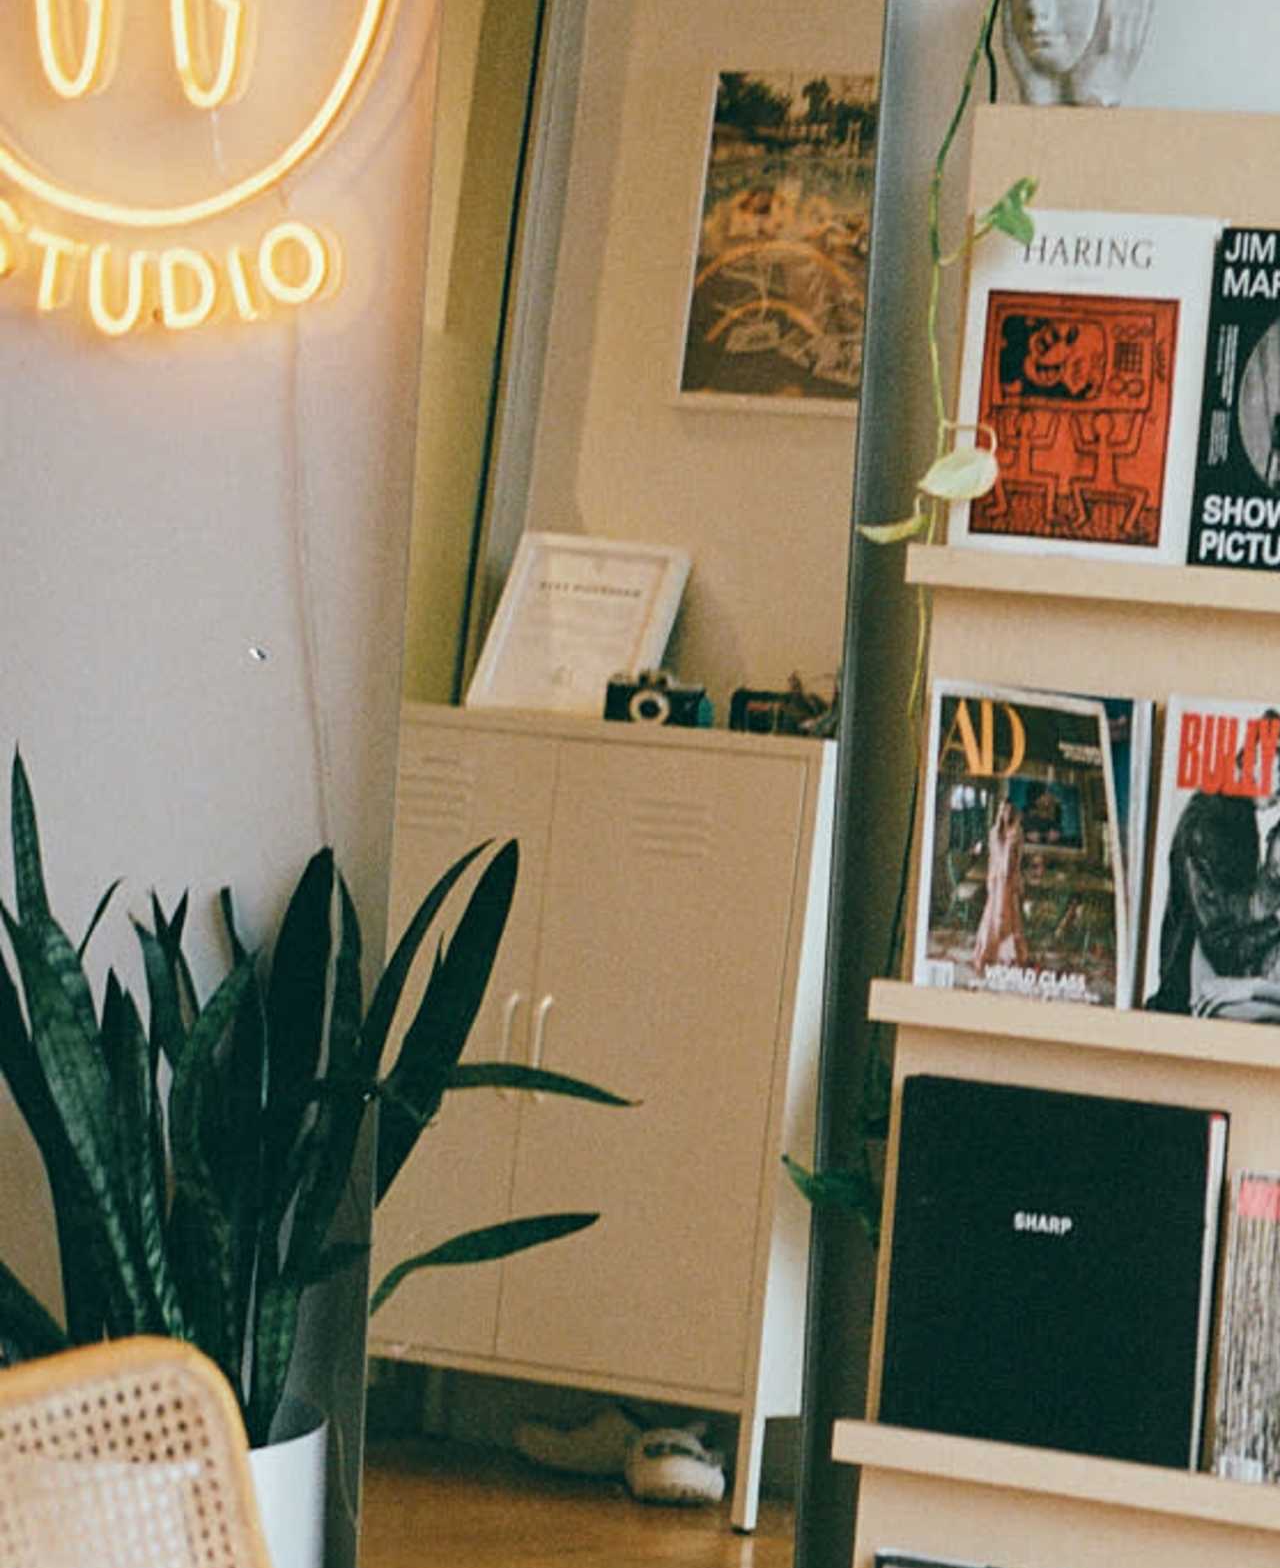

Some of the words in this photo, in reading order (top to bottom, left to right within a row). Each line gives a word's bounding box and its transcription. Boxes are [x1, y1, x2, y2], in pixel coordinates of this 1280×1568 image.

[1023, 234, 1153, 269] HARING
[1224, 233, 1276, 265] JIM
[938, 698, 1026, 777] AD
[1014, 1210, 1072, 1237] SHARP
